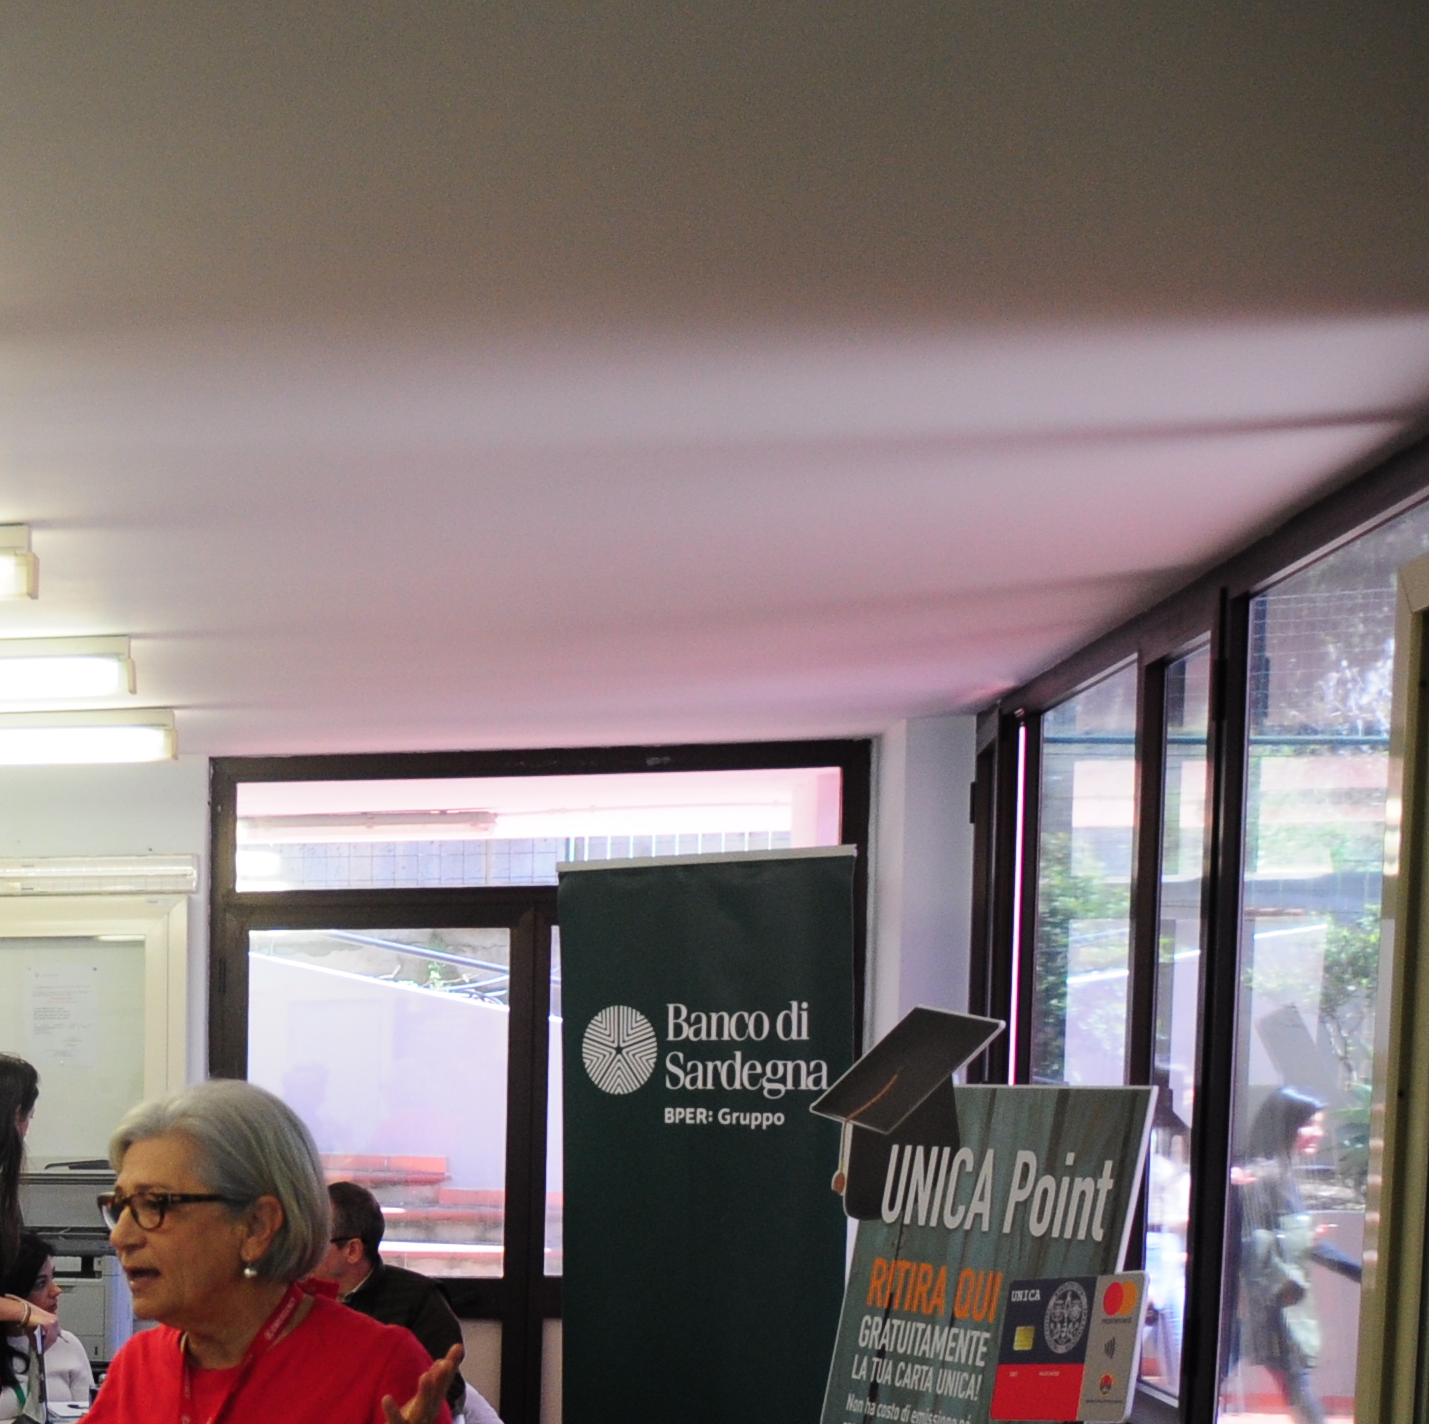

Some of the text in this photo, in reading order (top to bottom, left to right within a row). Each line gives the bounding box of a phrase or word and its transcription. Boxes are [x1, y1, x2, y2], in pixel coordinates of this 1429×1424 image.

[666, 1001, 810, 1041] Banco di
[665, 1051, 829, 1099] Sardegna
[664, 1107, 785, 1130] BPER: Gruppo
[881, 1143, 1114, 1242] UNICA Point
[866, 1257, 1004, 1323] RITIRA QUI
[1011, 1288, 1041, 1302] UNICA
[858, 1315, 991, 1368] GRATUITAMENTE
[851, 1354, 983, 1401] LA TUA CARTA UNICA!
[845, 1392, 864, 1414] Non
[864, 1396, 876, 1416] ha
[876, 1400, 900, 1421] costo
[900, 1402, 911, 1422] di
